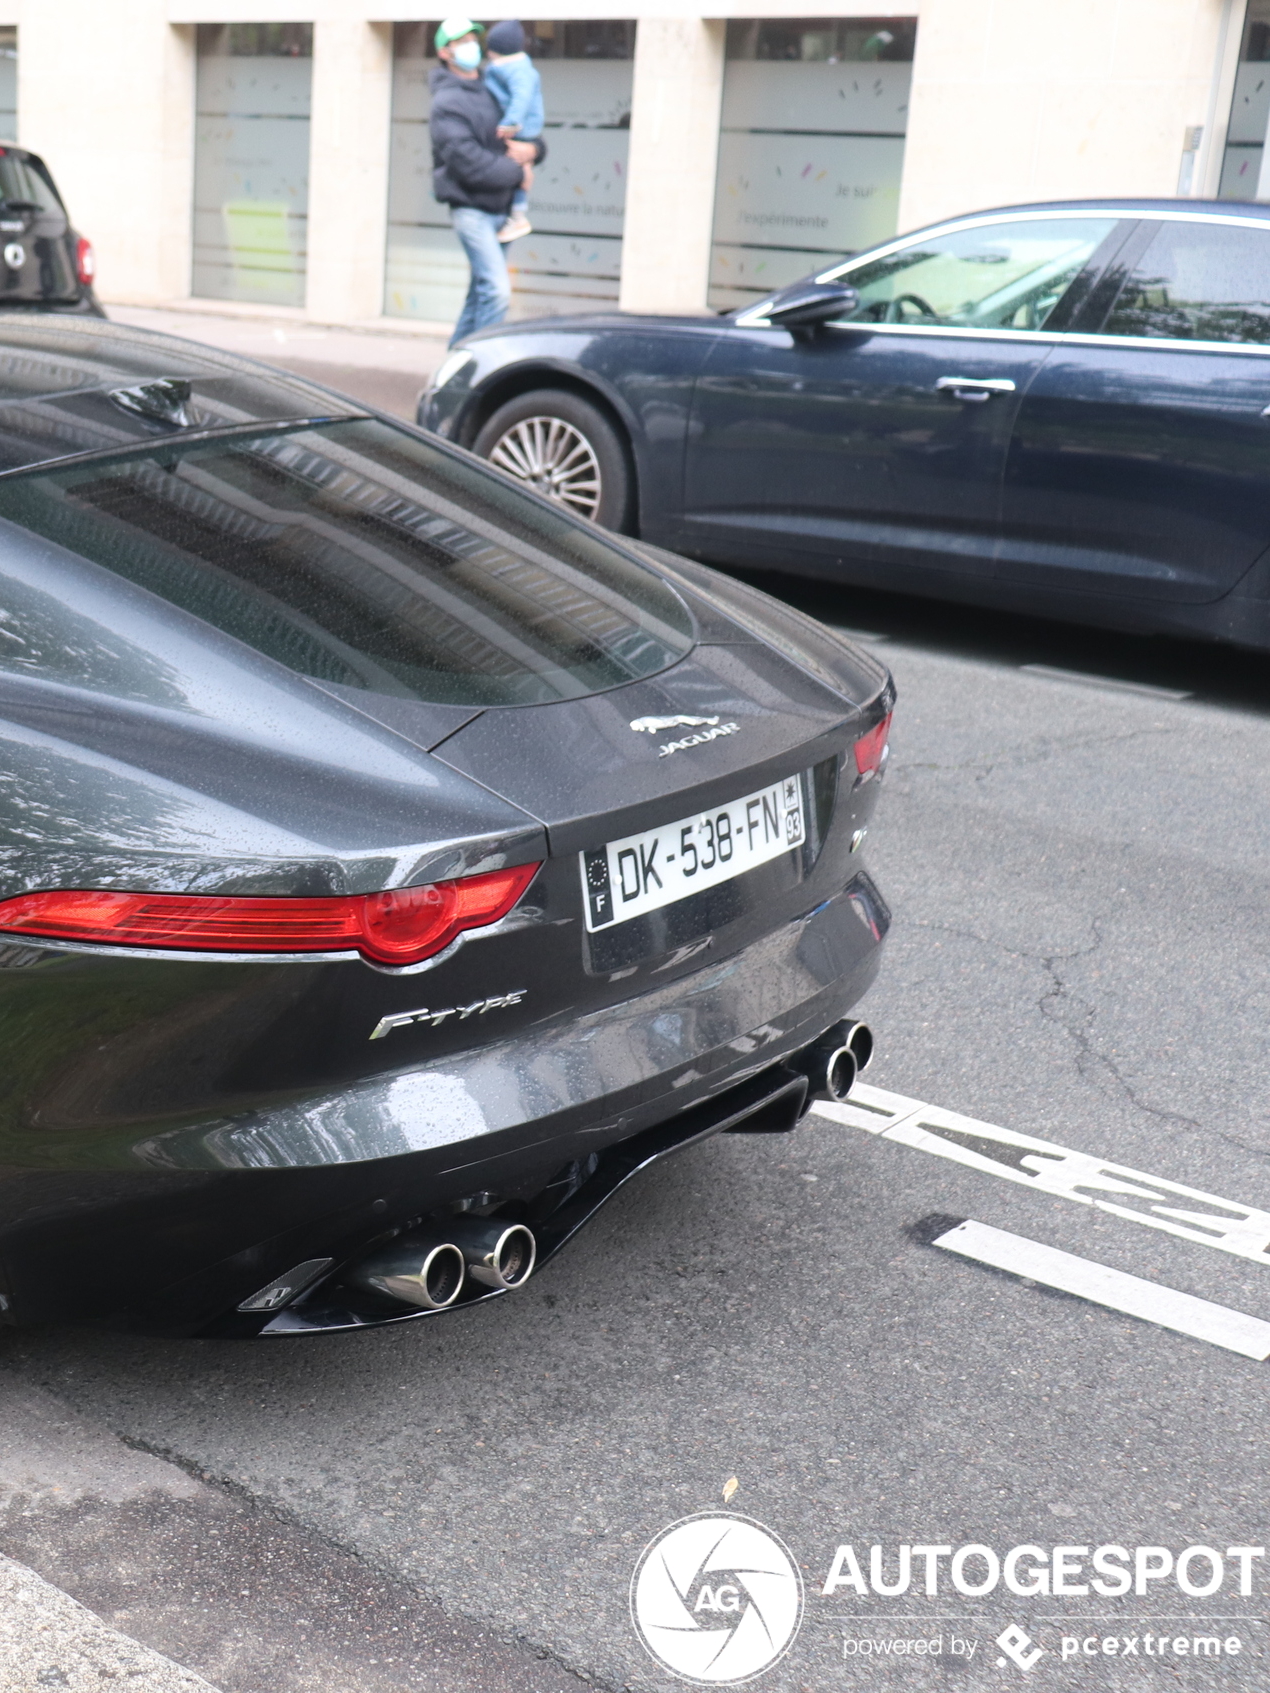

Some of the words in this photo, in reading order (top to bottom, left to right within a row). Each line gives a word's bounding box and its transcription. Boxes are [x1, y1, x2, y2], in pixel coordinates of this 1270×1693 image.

[659, 722, 741, 758] JAGUAR
[596, 894, 605, 912] F
[617, 791, 780, 903] DK-538-FN
[786, 811, 800, 839] 93
[368, 989, 528, 1041] F-TYPE
